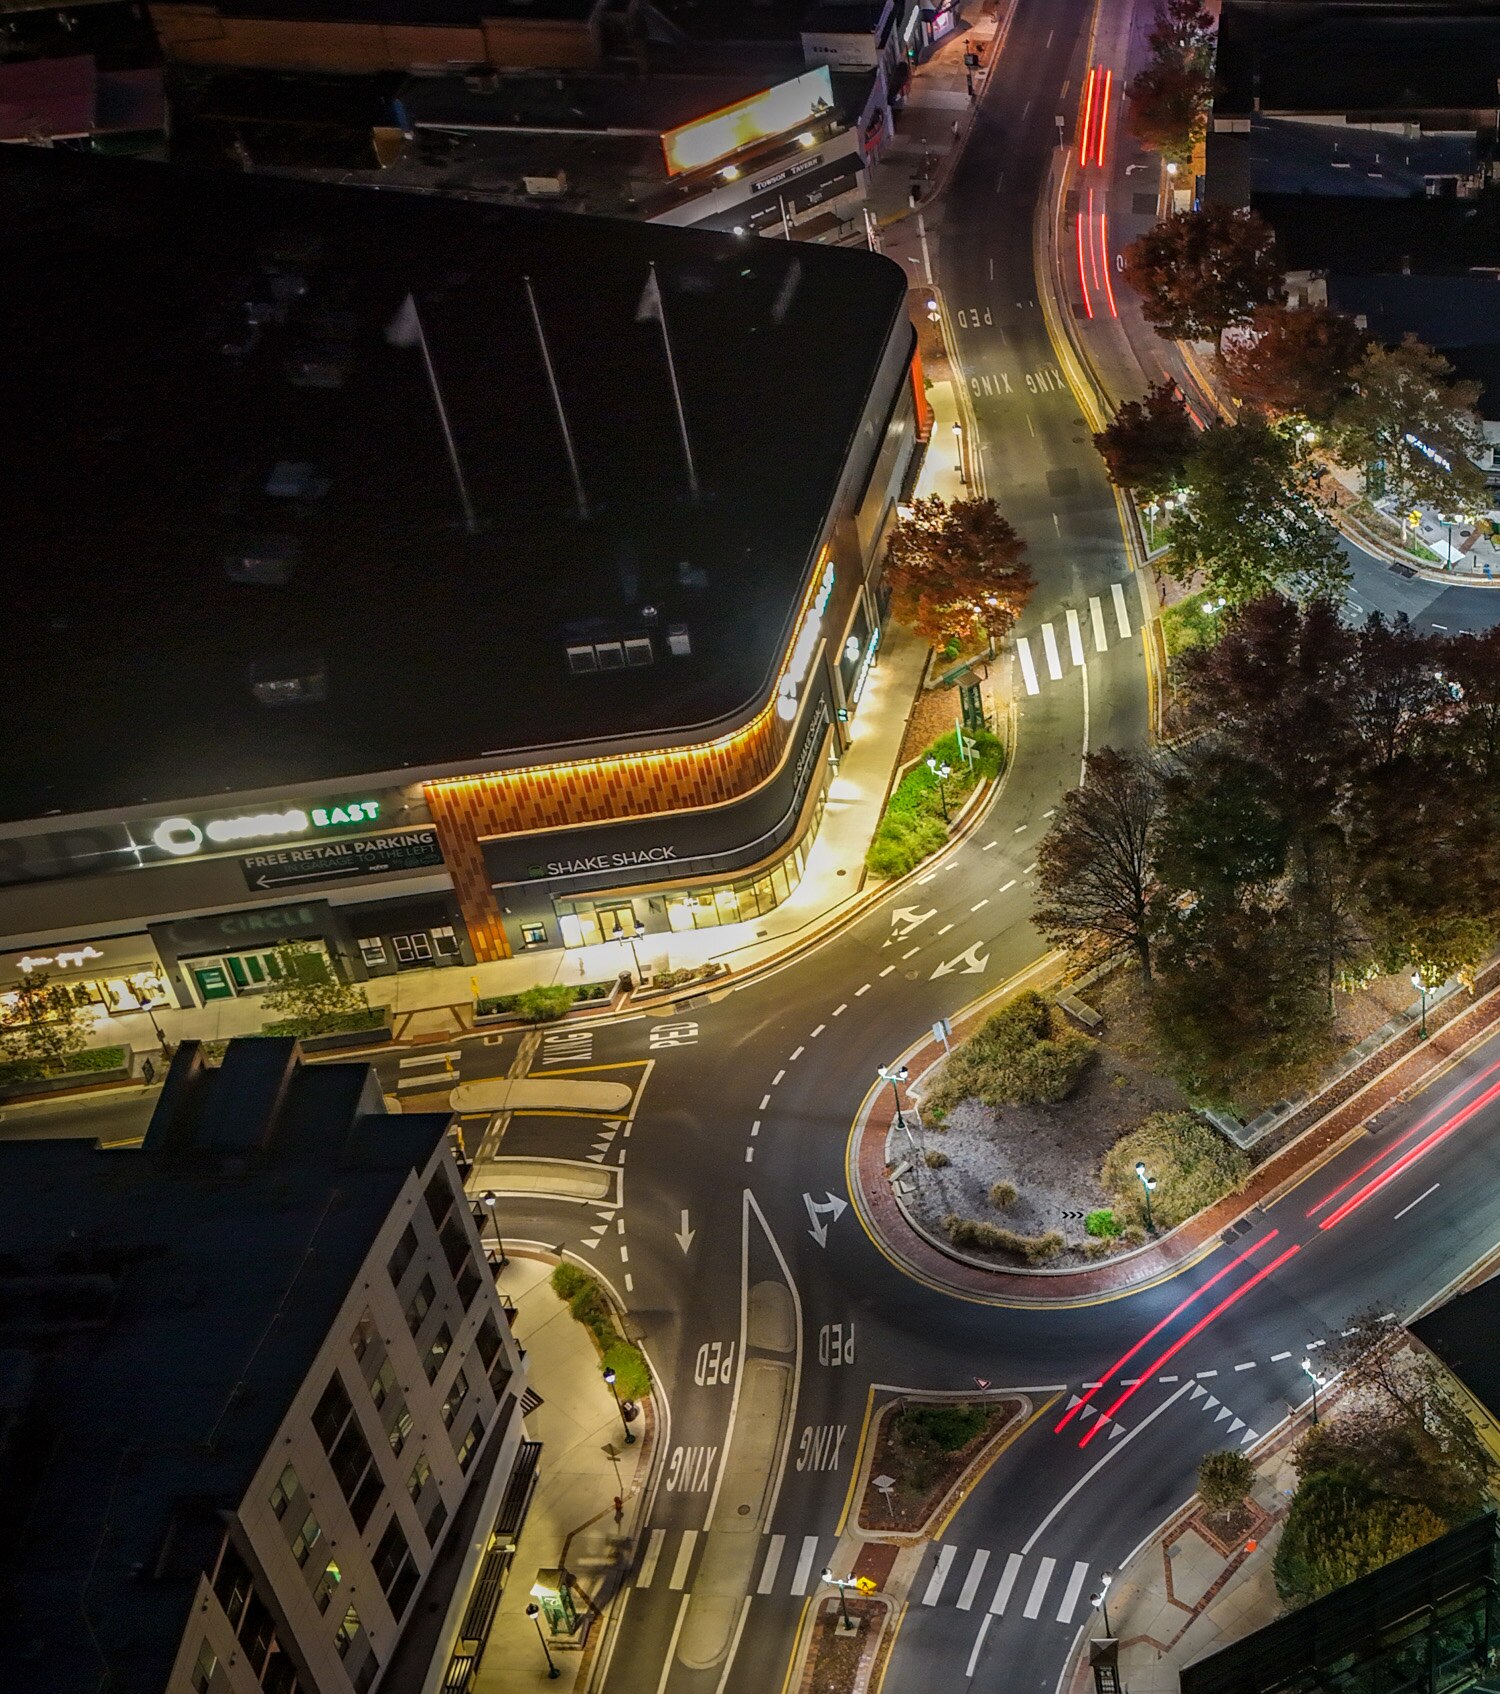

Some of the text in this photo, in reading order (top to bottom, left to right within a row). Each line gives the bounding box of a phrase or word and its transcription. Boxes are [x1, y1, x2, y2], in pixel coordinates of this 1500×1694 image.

[756, 158, 818, 190] TOWSON TAVERN
[958, 307, 992, 328] PED
[971, 373, 1013, 397] XING
[1025, 369, 1065, 393] XING
[311, 801, 380, 827] EAST
[245, 832, 434, 868] FREE RETAIL PARKING
[301, 857, 351, 872] GARAGE
[352, 854, 375, 866] TO
[378, 850, 403, 862] THE
[405, 844, 436, 856] LEFT
[547, 846, 677, 876] SHAKE SHACK
[220, 908, 314, 934] CIRCLE
[542, 1021, 699, 1065] XING PED
[819, 1323, 855, 1367] PED
[694, 1341, 735, 1386] PED
[796, 1425, 847, 1471] XING
[666, 1446, 717, 1492] XING
